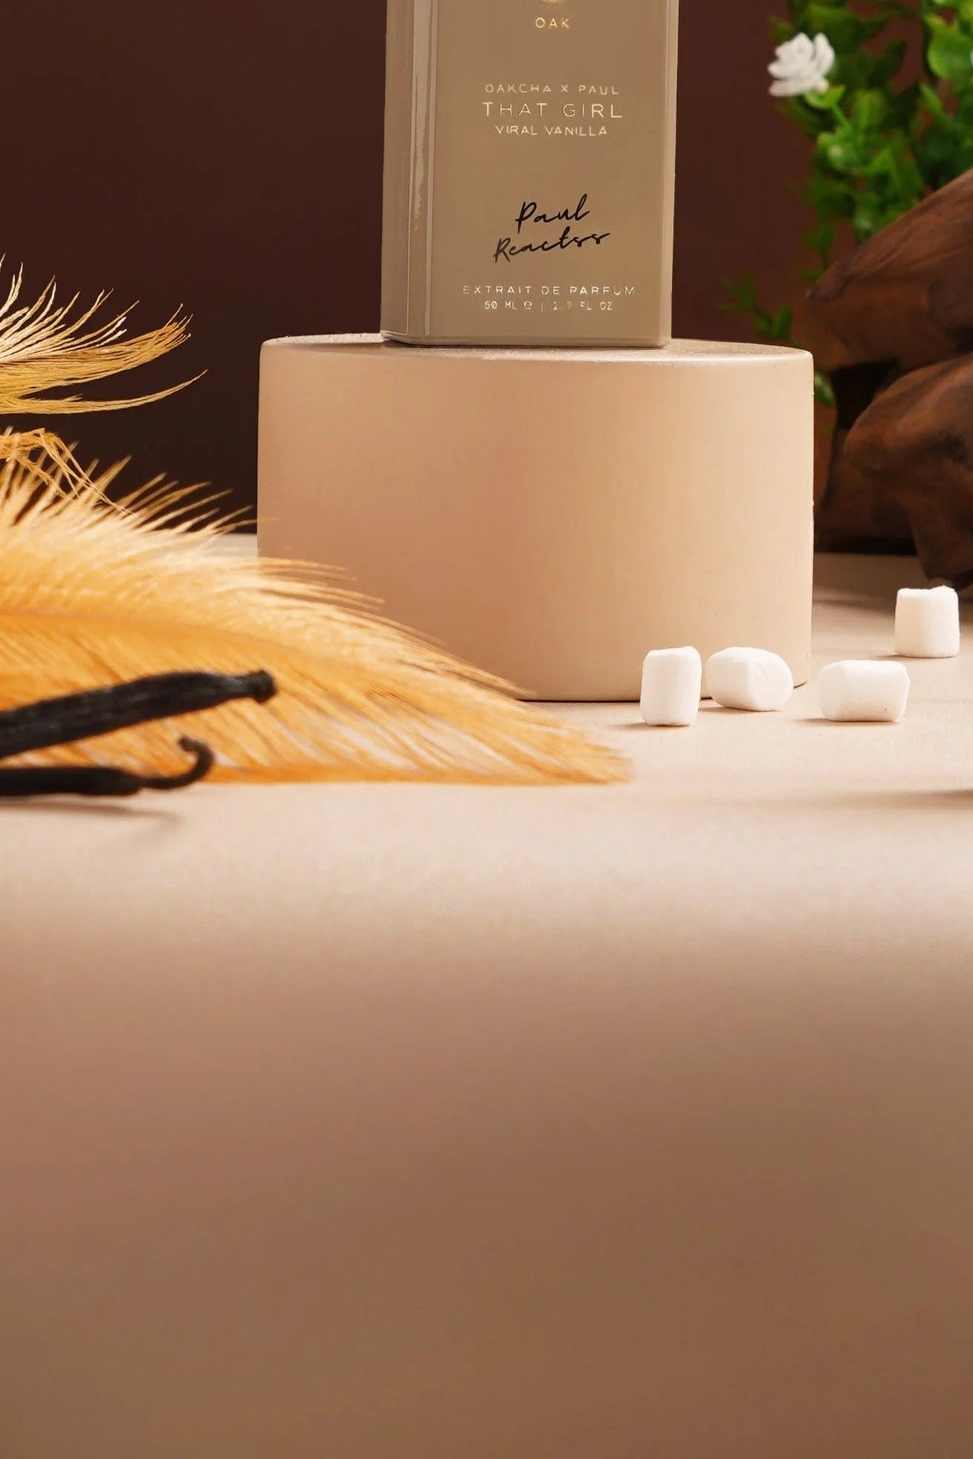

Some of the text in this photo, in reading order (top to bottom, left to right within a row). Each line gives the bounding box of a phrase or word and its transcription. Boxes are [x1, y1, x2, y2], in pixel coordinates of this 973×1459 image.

[535, 17, 570, 28] OAK
[485, 84, 552, 94] OAKCHA
[579, 84, 620, 95] PAUL
[482, 102, 623, 118] THAT GIRL
[494, 124, 608, 136] VIRAL VANILLA
[515, 193, 590, 234] Paul
[463, 285, 635, 296] EXTRAIT DE PARFUM
[484, 301, 498, 310] 50
[505, 301, 516, 310] ML
[600, 302, 613, 311] OZ
